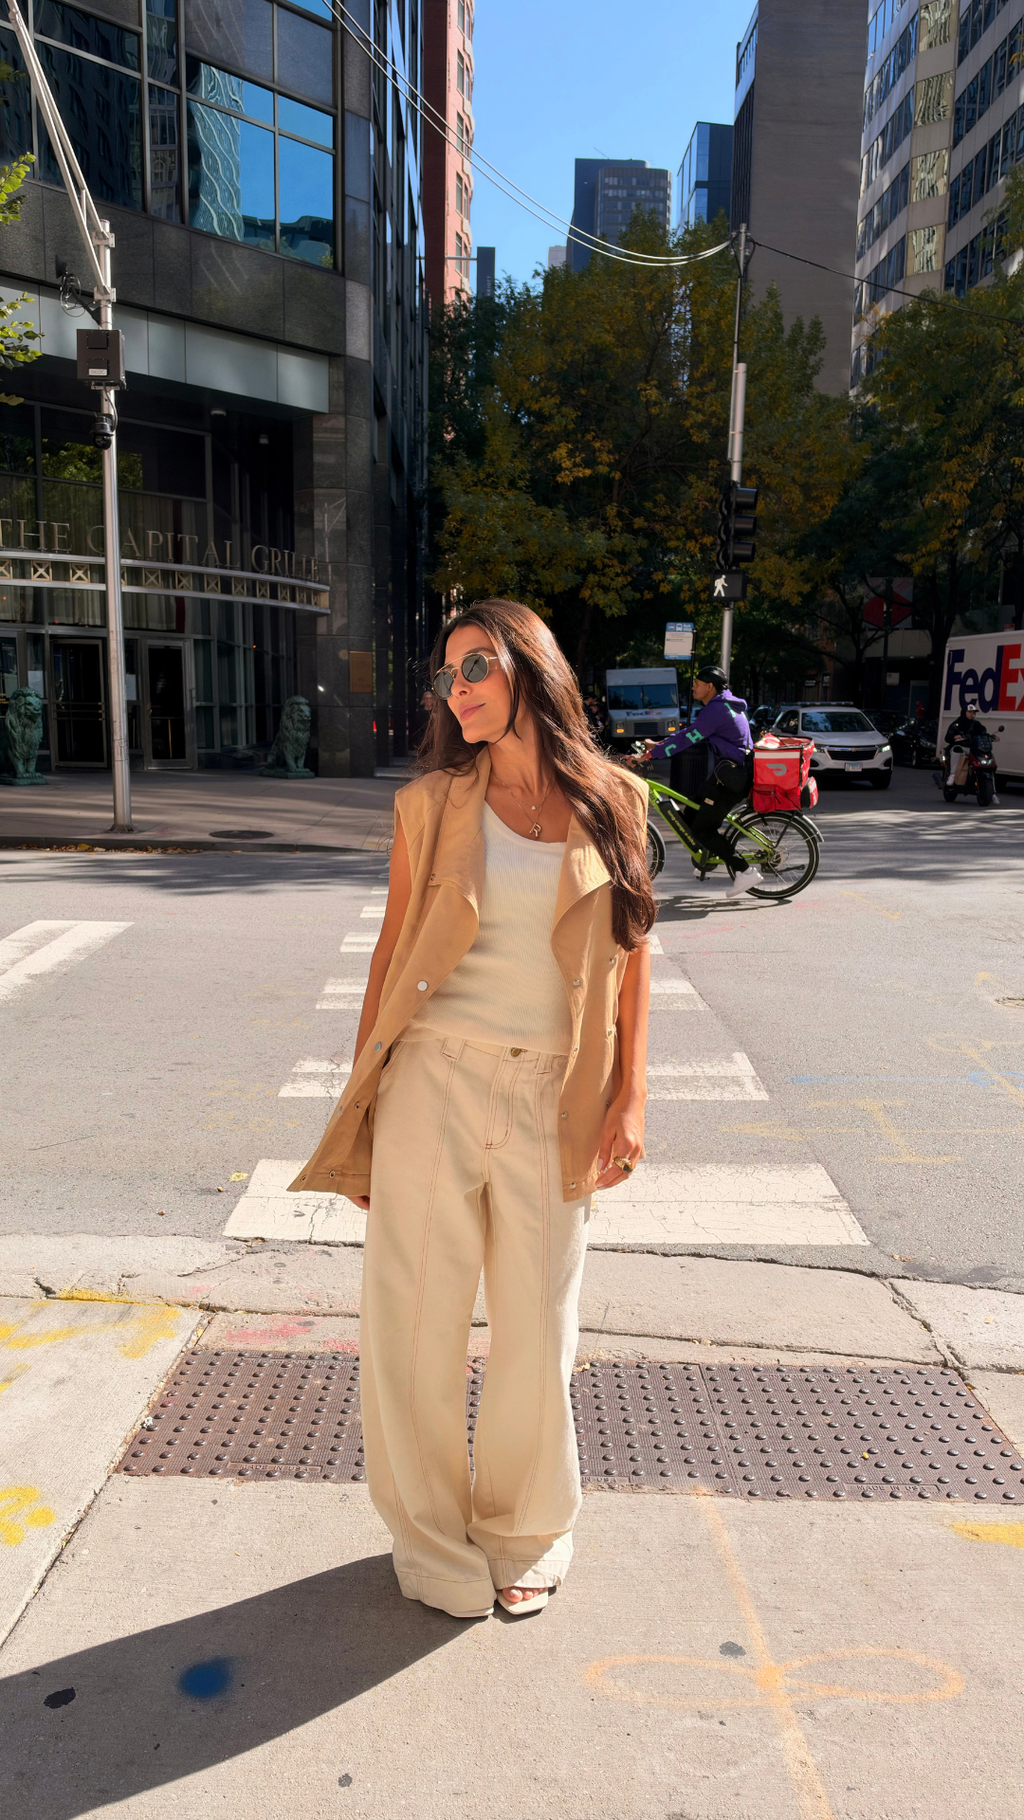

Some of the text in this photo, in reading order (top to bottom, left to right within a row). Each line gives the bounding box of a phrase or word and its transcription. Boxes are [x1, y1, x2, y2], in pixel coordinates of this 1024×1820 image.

[0, 518, 320, 582] THE CAPITAL GRILLE
[529, 822, 541, 837] R
